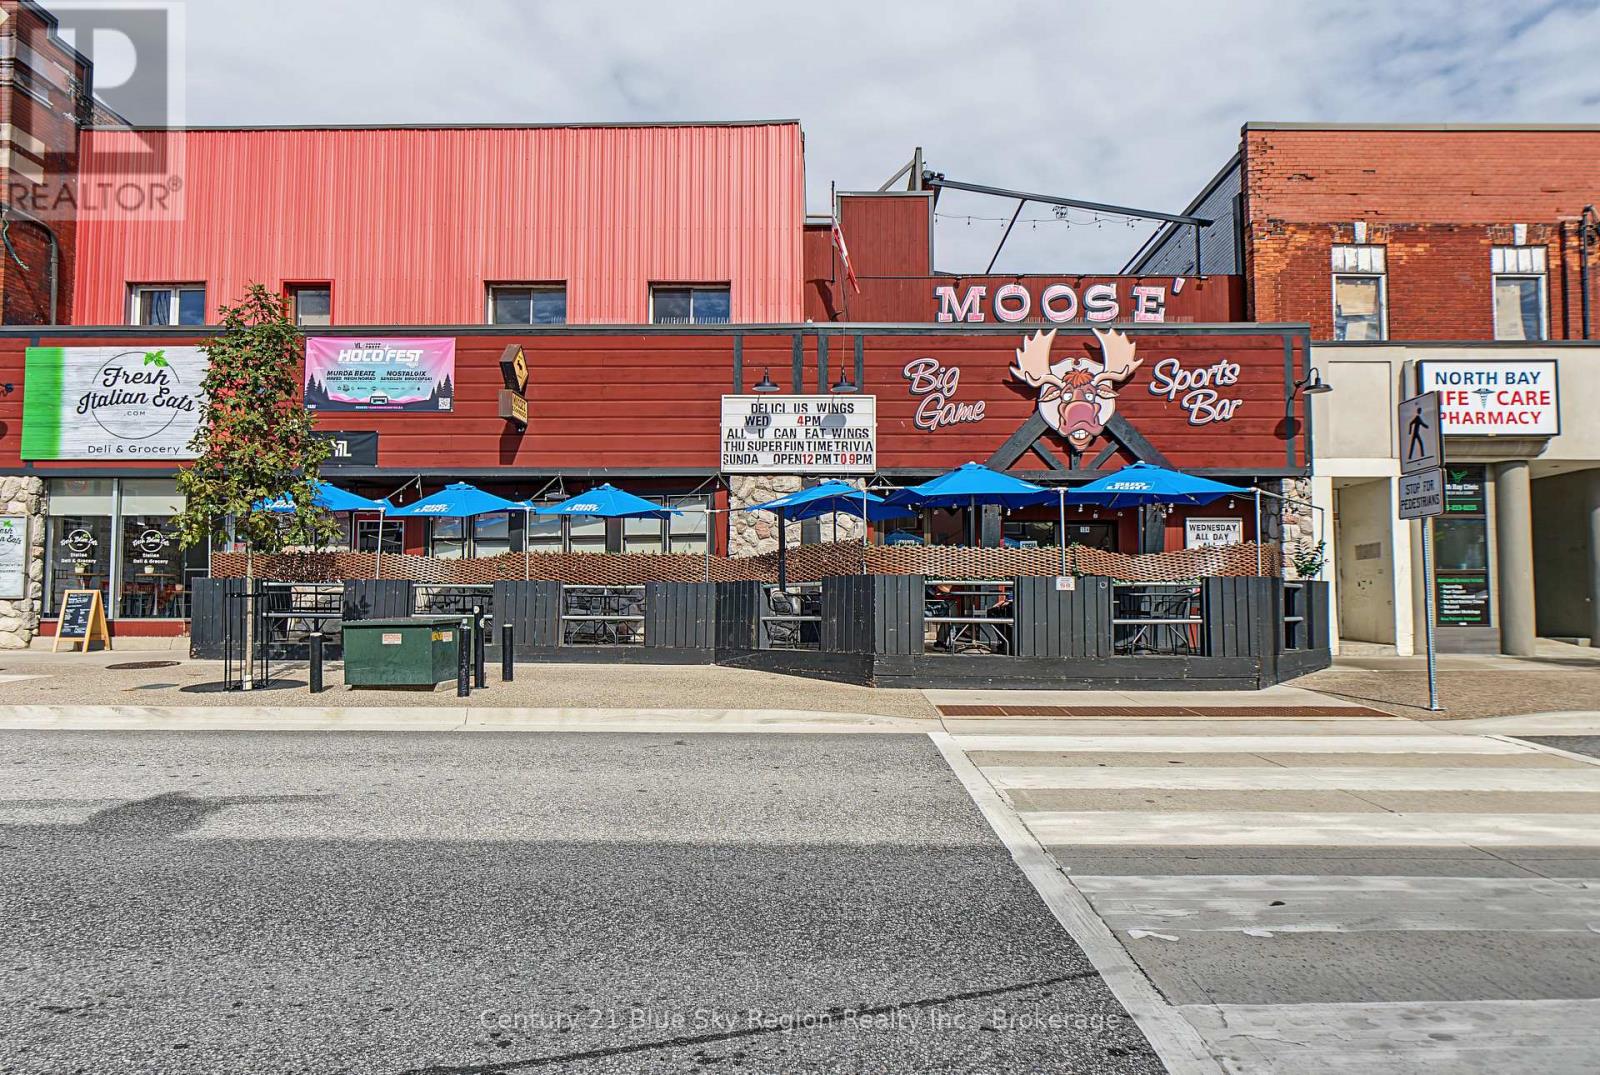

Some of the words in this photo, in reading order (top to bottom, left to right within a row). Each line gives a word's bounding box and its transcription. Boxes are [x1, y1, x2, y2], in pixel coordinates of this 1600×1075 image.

[102, 366, 170, 387] Fresh
[903, 357, 960, 397] Big
[1148, 358, 1241, 401] Sports
[1435, 371, 1498, 385] NORTH
[1505, 371, 1541, 385] BAY
[76, 389, 149, 414] Italian
[152, 386, 195, 412] Eats
[1440, 391, 1469, 405] IFE
[1497, 391, 1551, 405] CARE
[816, 403, 854, 414] WINGS
[914, 392, 986, 431] Game
[1181, 389, 1243, 425] Bar
[745, 416, 769, 426] WED
[797, 416, 821, 426] 4PM
[727, 428, 747, 439] ALL
[758, 428, 765, 439] U
[774, 428, 797, 439] CAN
[805, 428, 826, 439] EAT
[831, 428, 869, 439] WINGS
[88, 445, 112, 453] Deli
[115, 445, 124, 453] &
[128, 445, 180, 456] Grocery
[723, 441, 745, 452] THU
[747, 441, 782, 452] SUPER
[784, 441, 804, 452] FUN
[806, 441, 833, 452] TIME
[834, 441, 873, 452] TRIVIA
[723, 454, 759, 465] SUNDA
[773, 454, 801, 465] OPEN
[849, 454, 872, 465] 9PM
[1406, 483, 1420, 495] STOP
[1423, 480, 1435, 492] FOR
[1400, 494, 1440, 511] PEDESTRIANS
